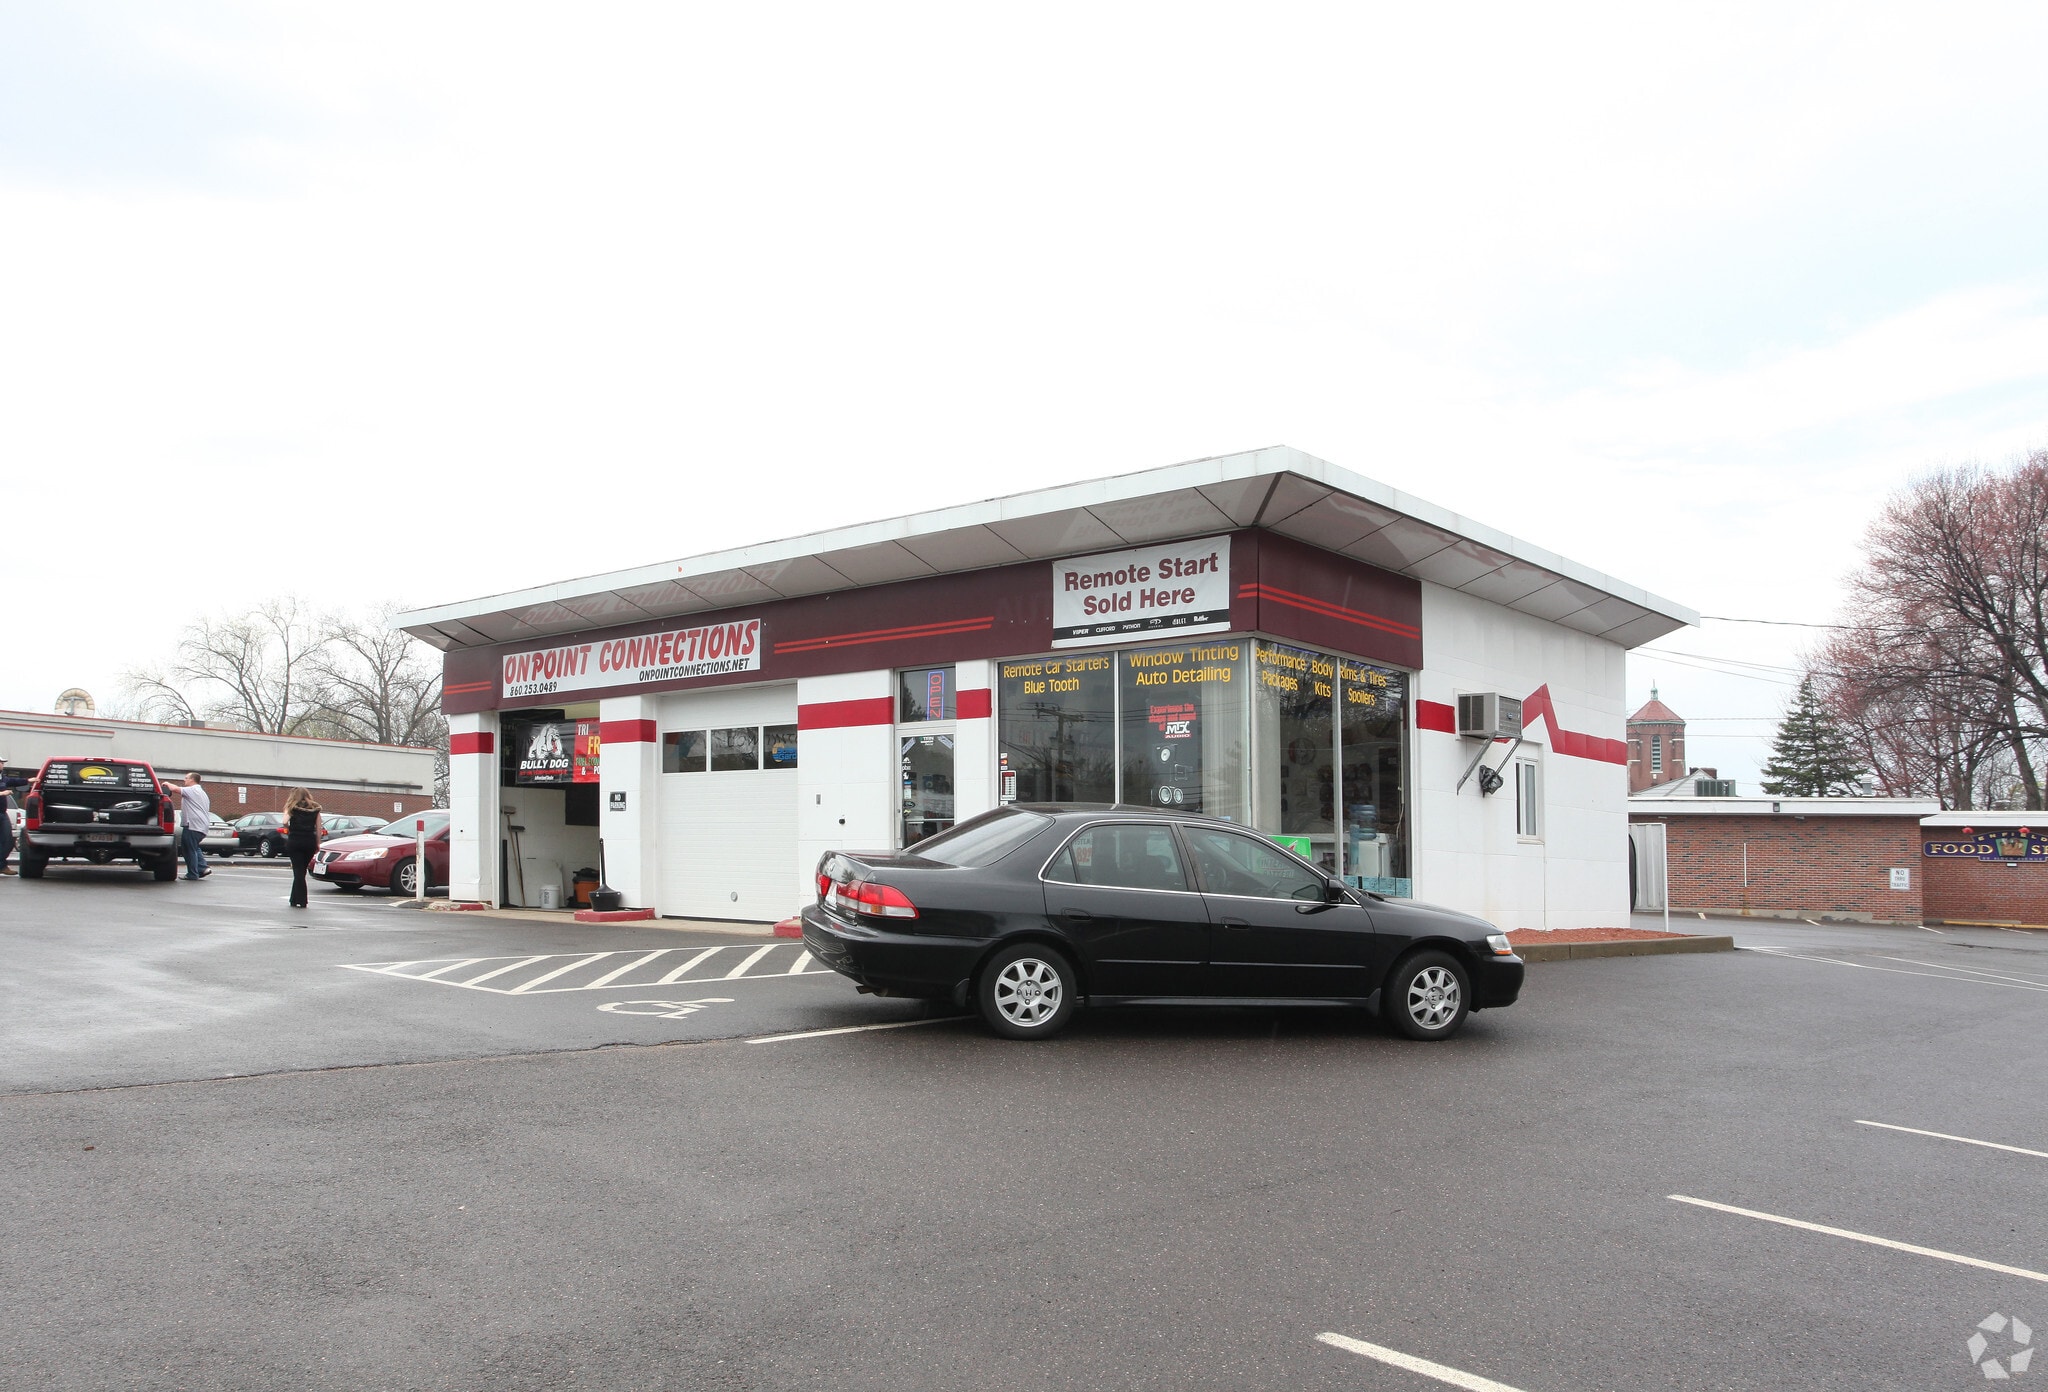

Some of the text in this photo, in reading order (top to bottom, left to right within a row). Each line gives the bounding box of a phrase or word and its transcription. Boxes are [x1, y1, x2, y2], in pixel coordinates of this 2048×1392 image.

[1064, 552, 1218, 591] Remote Start
[1083, 587, 1195, 615] Sold Here
[504, 621, 759, 684] ONPOINT CONNECTIONS
[1129, 644, 1239, 668] Window Tinting
[1255, 647, 1334, 679] Performance Body
[639, 658, 750, 681] ONPOINTCONNECTIONS.NET
[1003, 656, 1110, 678] Remote Car Starters
[1136, 666, 1231, 685] Auto Detailing
[1339, 664, 1387, 687] Rims & Tires
[510, 682, 557, 696] 860.253.0489
[1024, 677, 1080, 694] Blue Tooth
[1262, 670, 1332, 698] Packages Kits
[930, 674, 942, 718] OPEN
[1347, 687, 1376, 706] Spoilers
[1165, 721, 1190, 734] MTX
[520, 759, 569, 770] BULLY DOG
[581, 766, 586, 775] &
[1930, 844, 1993, 854] FOOD
